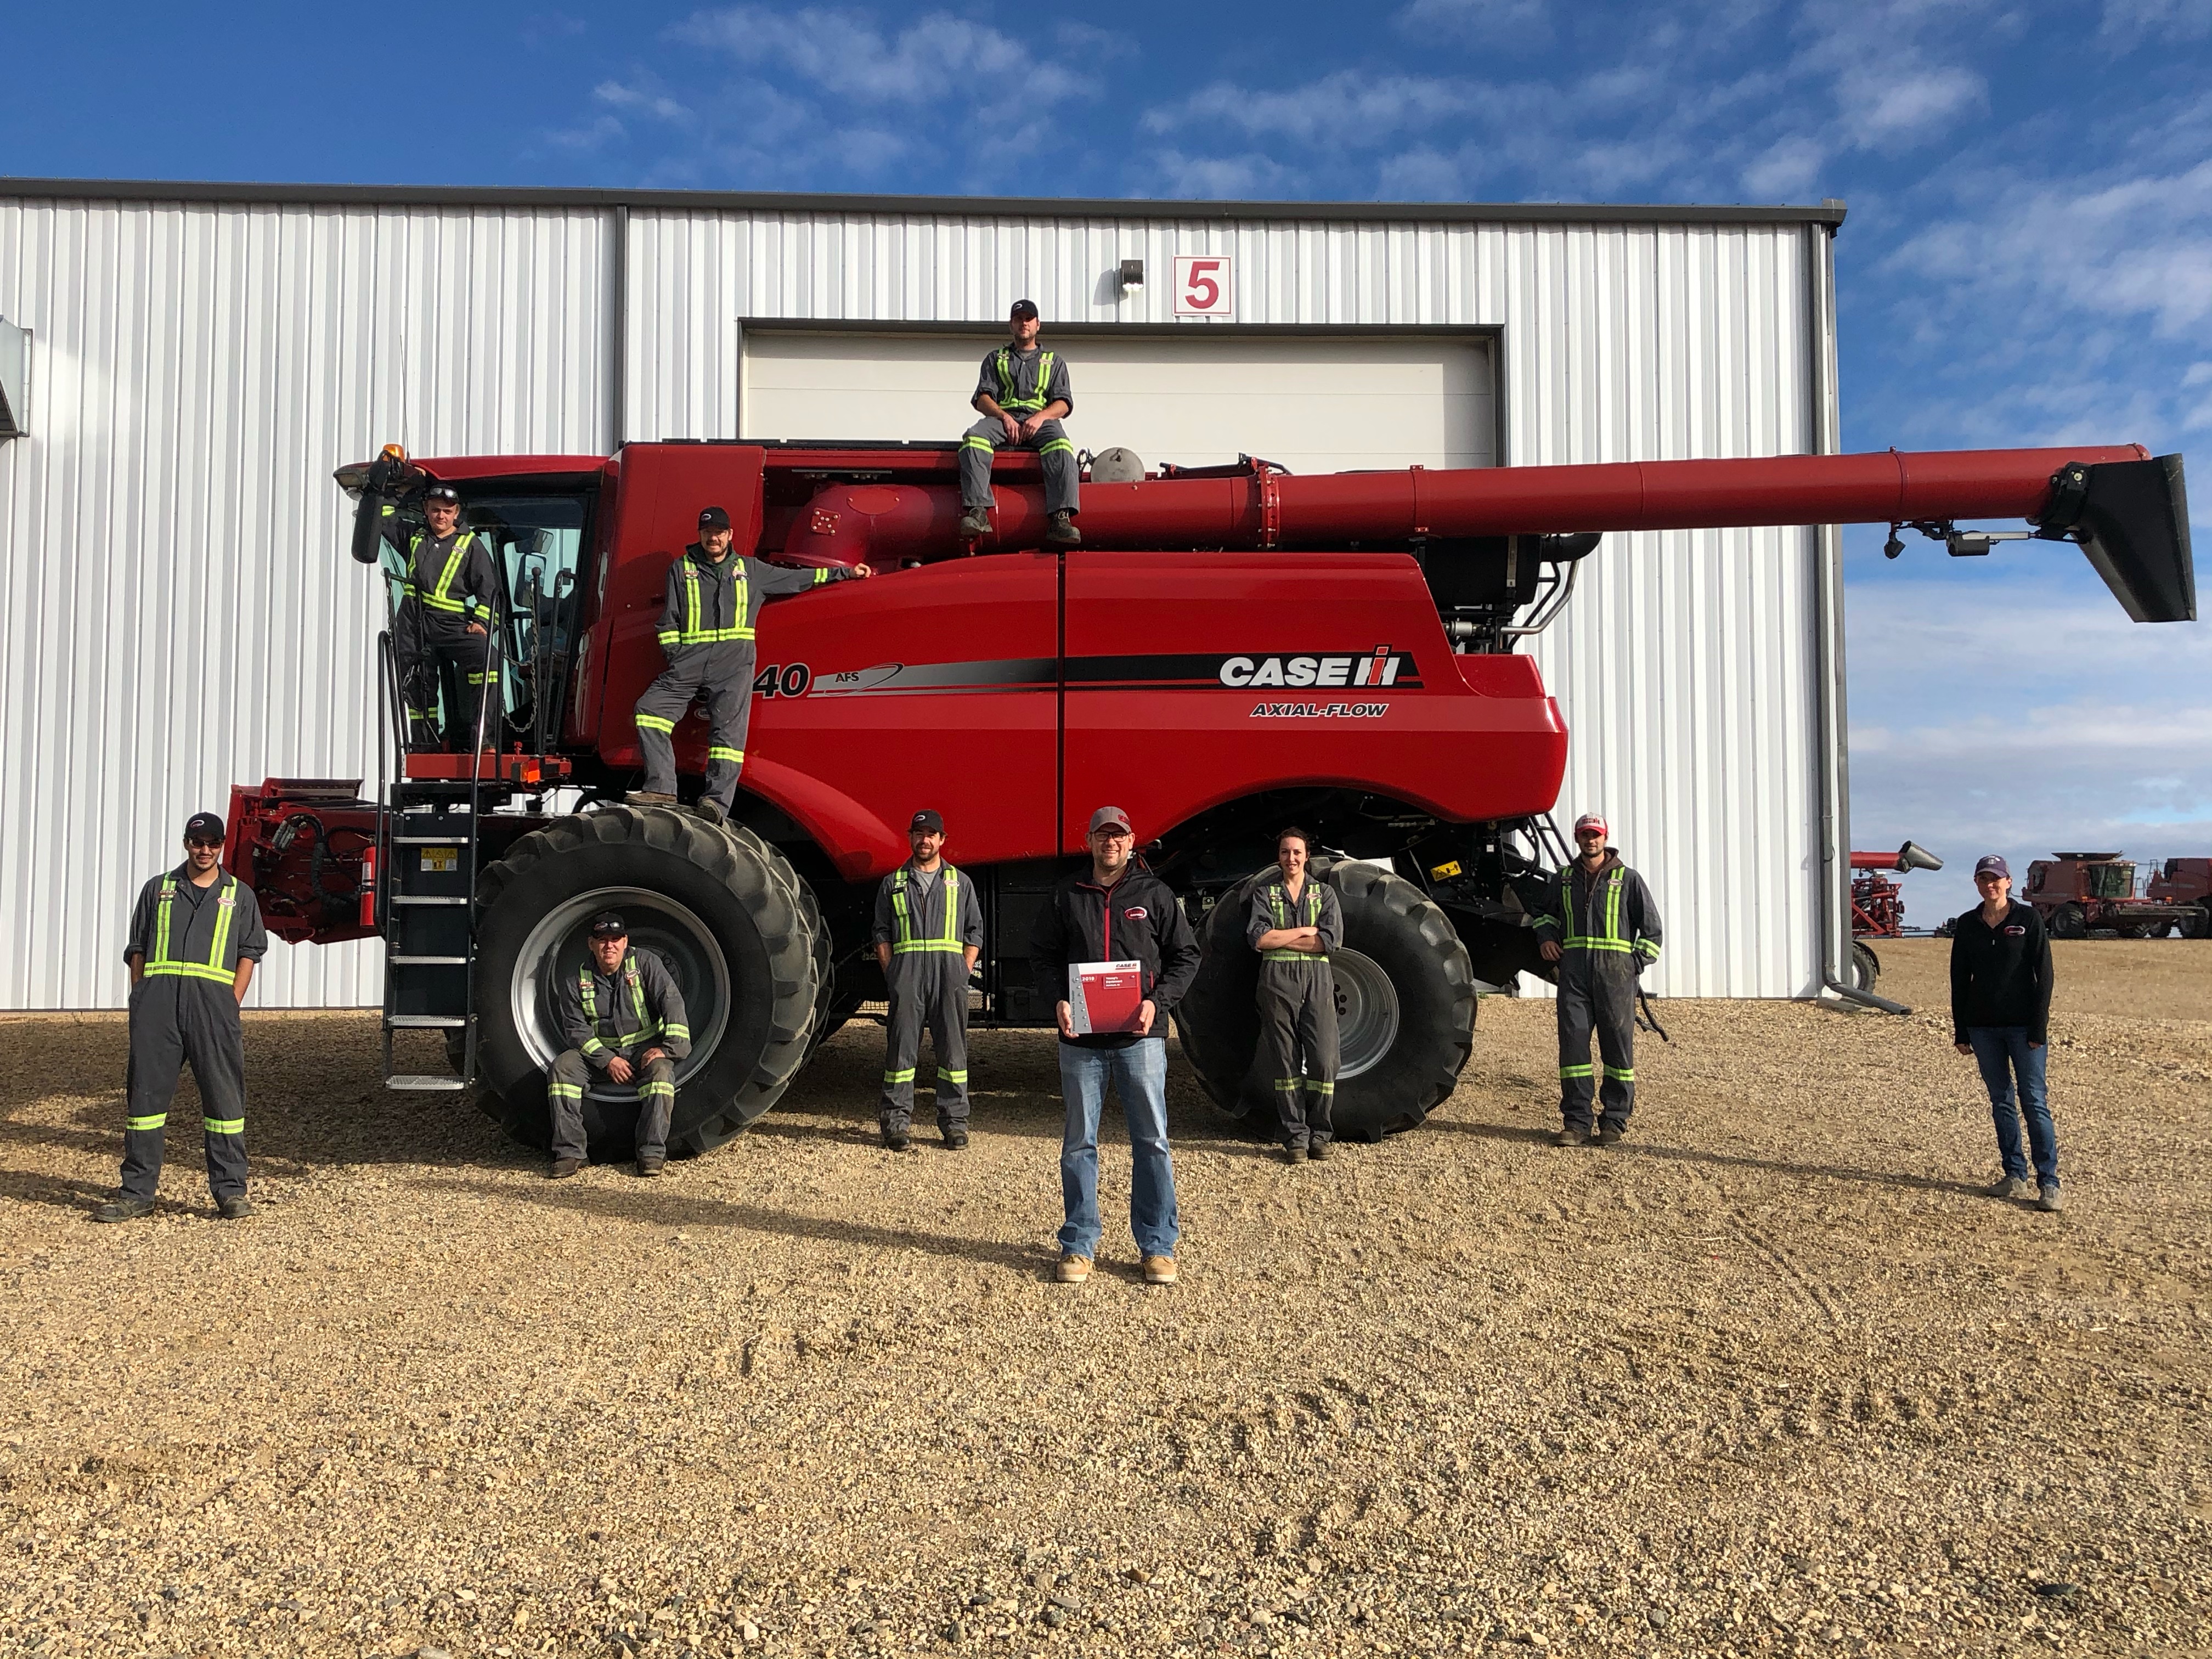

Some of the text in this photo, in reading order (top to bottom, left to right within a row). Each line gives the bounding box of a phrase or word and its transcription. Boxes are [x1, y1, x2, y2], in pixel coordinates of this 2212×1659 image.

[1185, 261, 1220, 309] 5
[835, 672, 859, 682] AFS
[1220, 657, 1352, 686] CASE
[1249, 703, 1389, 718] AXIAL-FLOW
